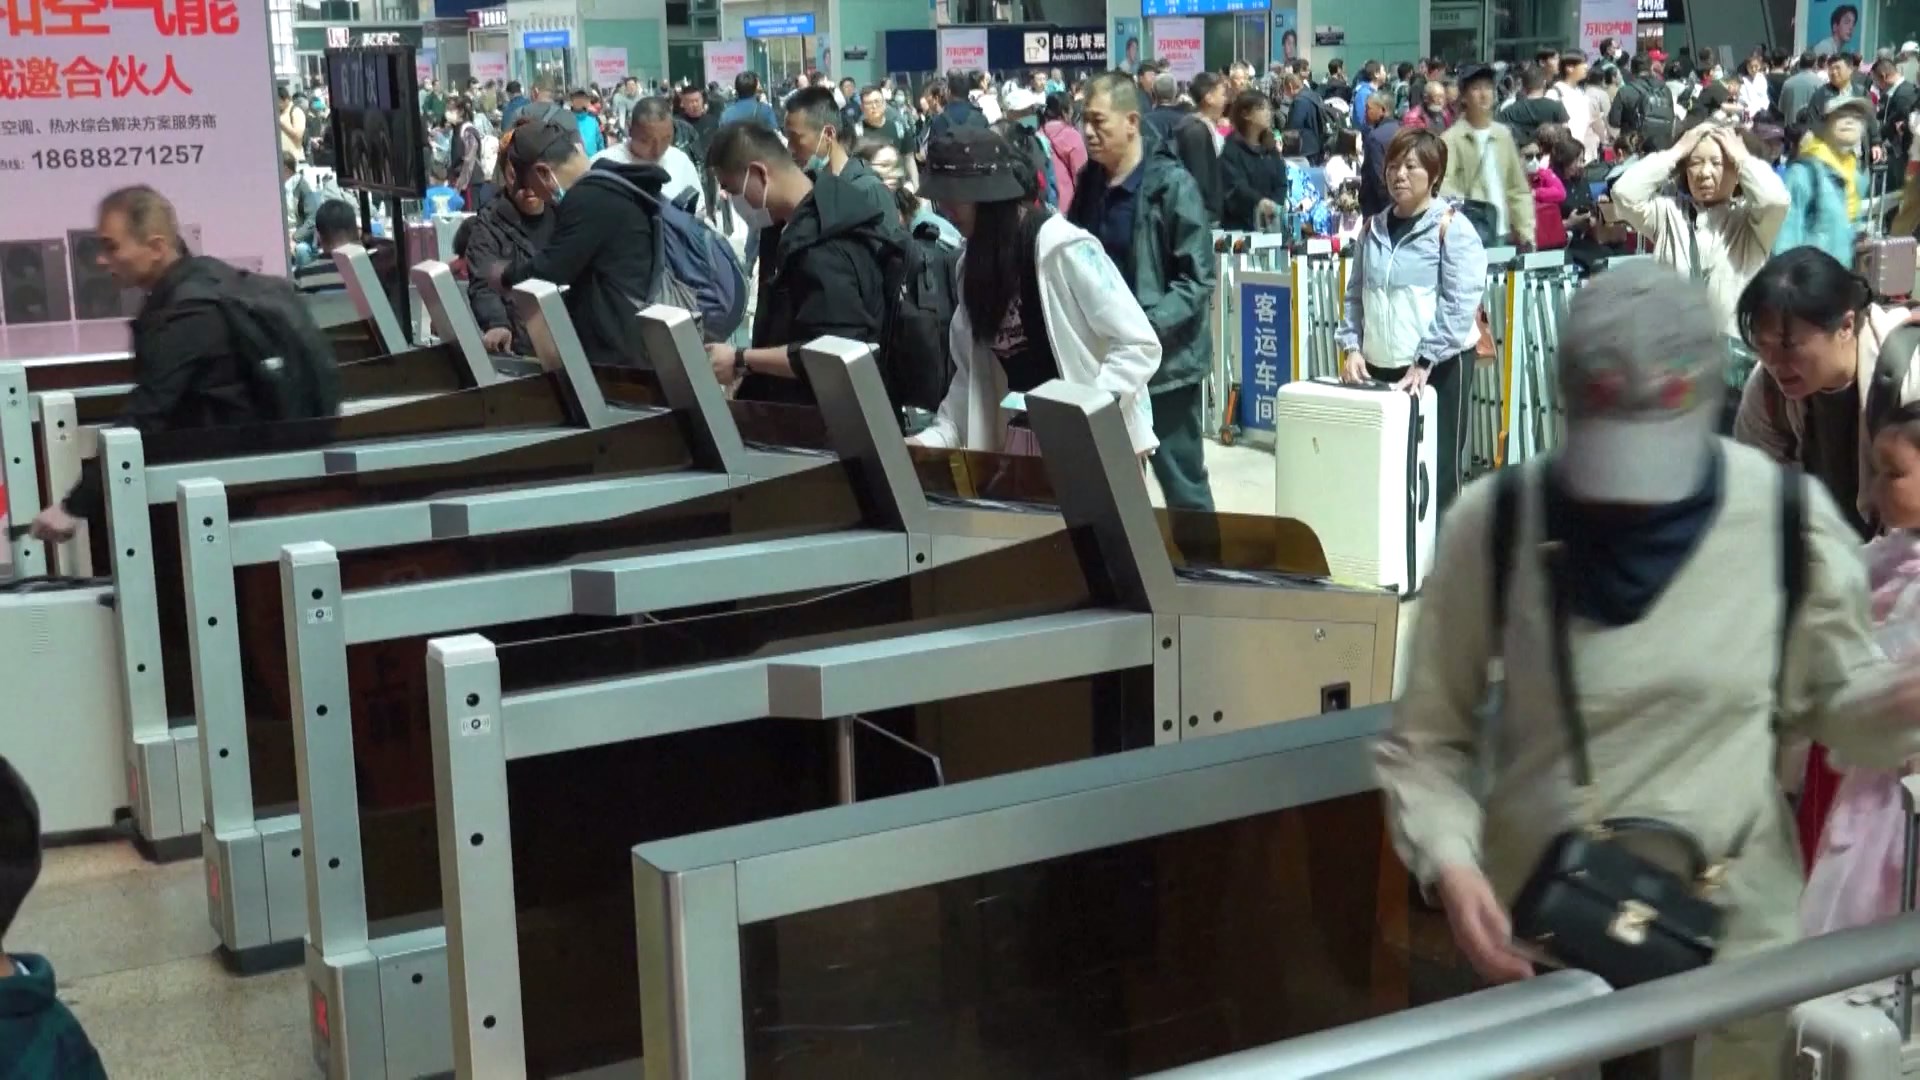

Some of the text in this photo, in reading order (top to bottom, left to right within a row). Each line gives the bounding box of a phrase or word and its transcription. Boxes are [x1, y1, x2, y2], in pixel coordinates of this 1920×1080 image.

[0, 0, 240, 36] 空气能
[362, 32, 400, 47] KFC
[1052, 33, 1106, 49] 自动售票
[1052, 53, 1085, 61] Automatic
[32, 145, 204, 169] 18688271257
[1254, 292, 1278, 424] 客运车间
